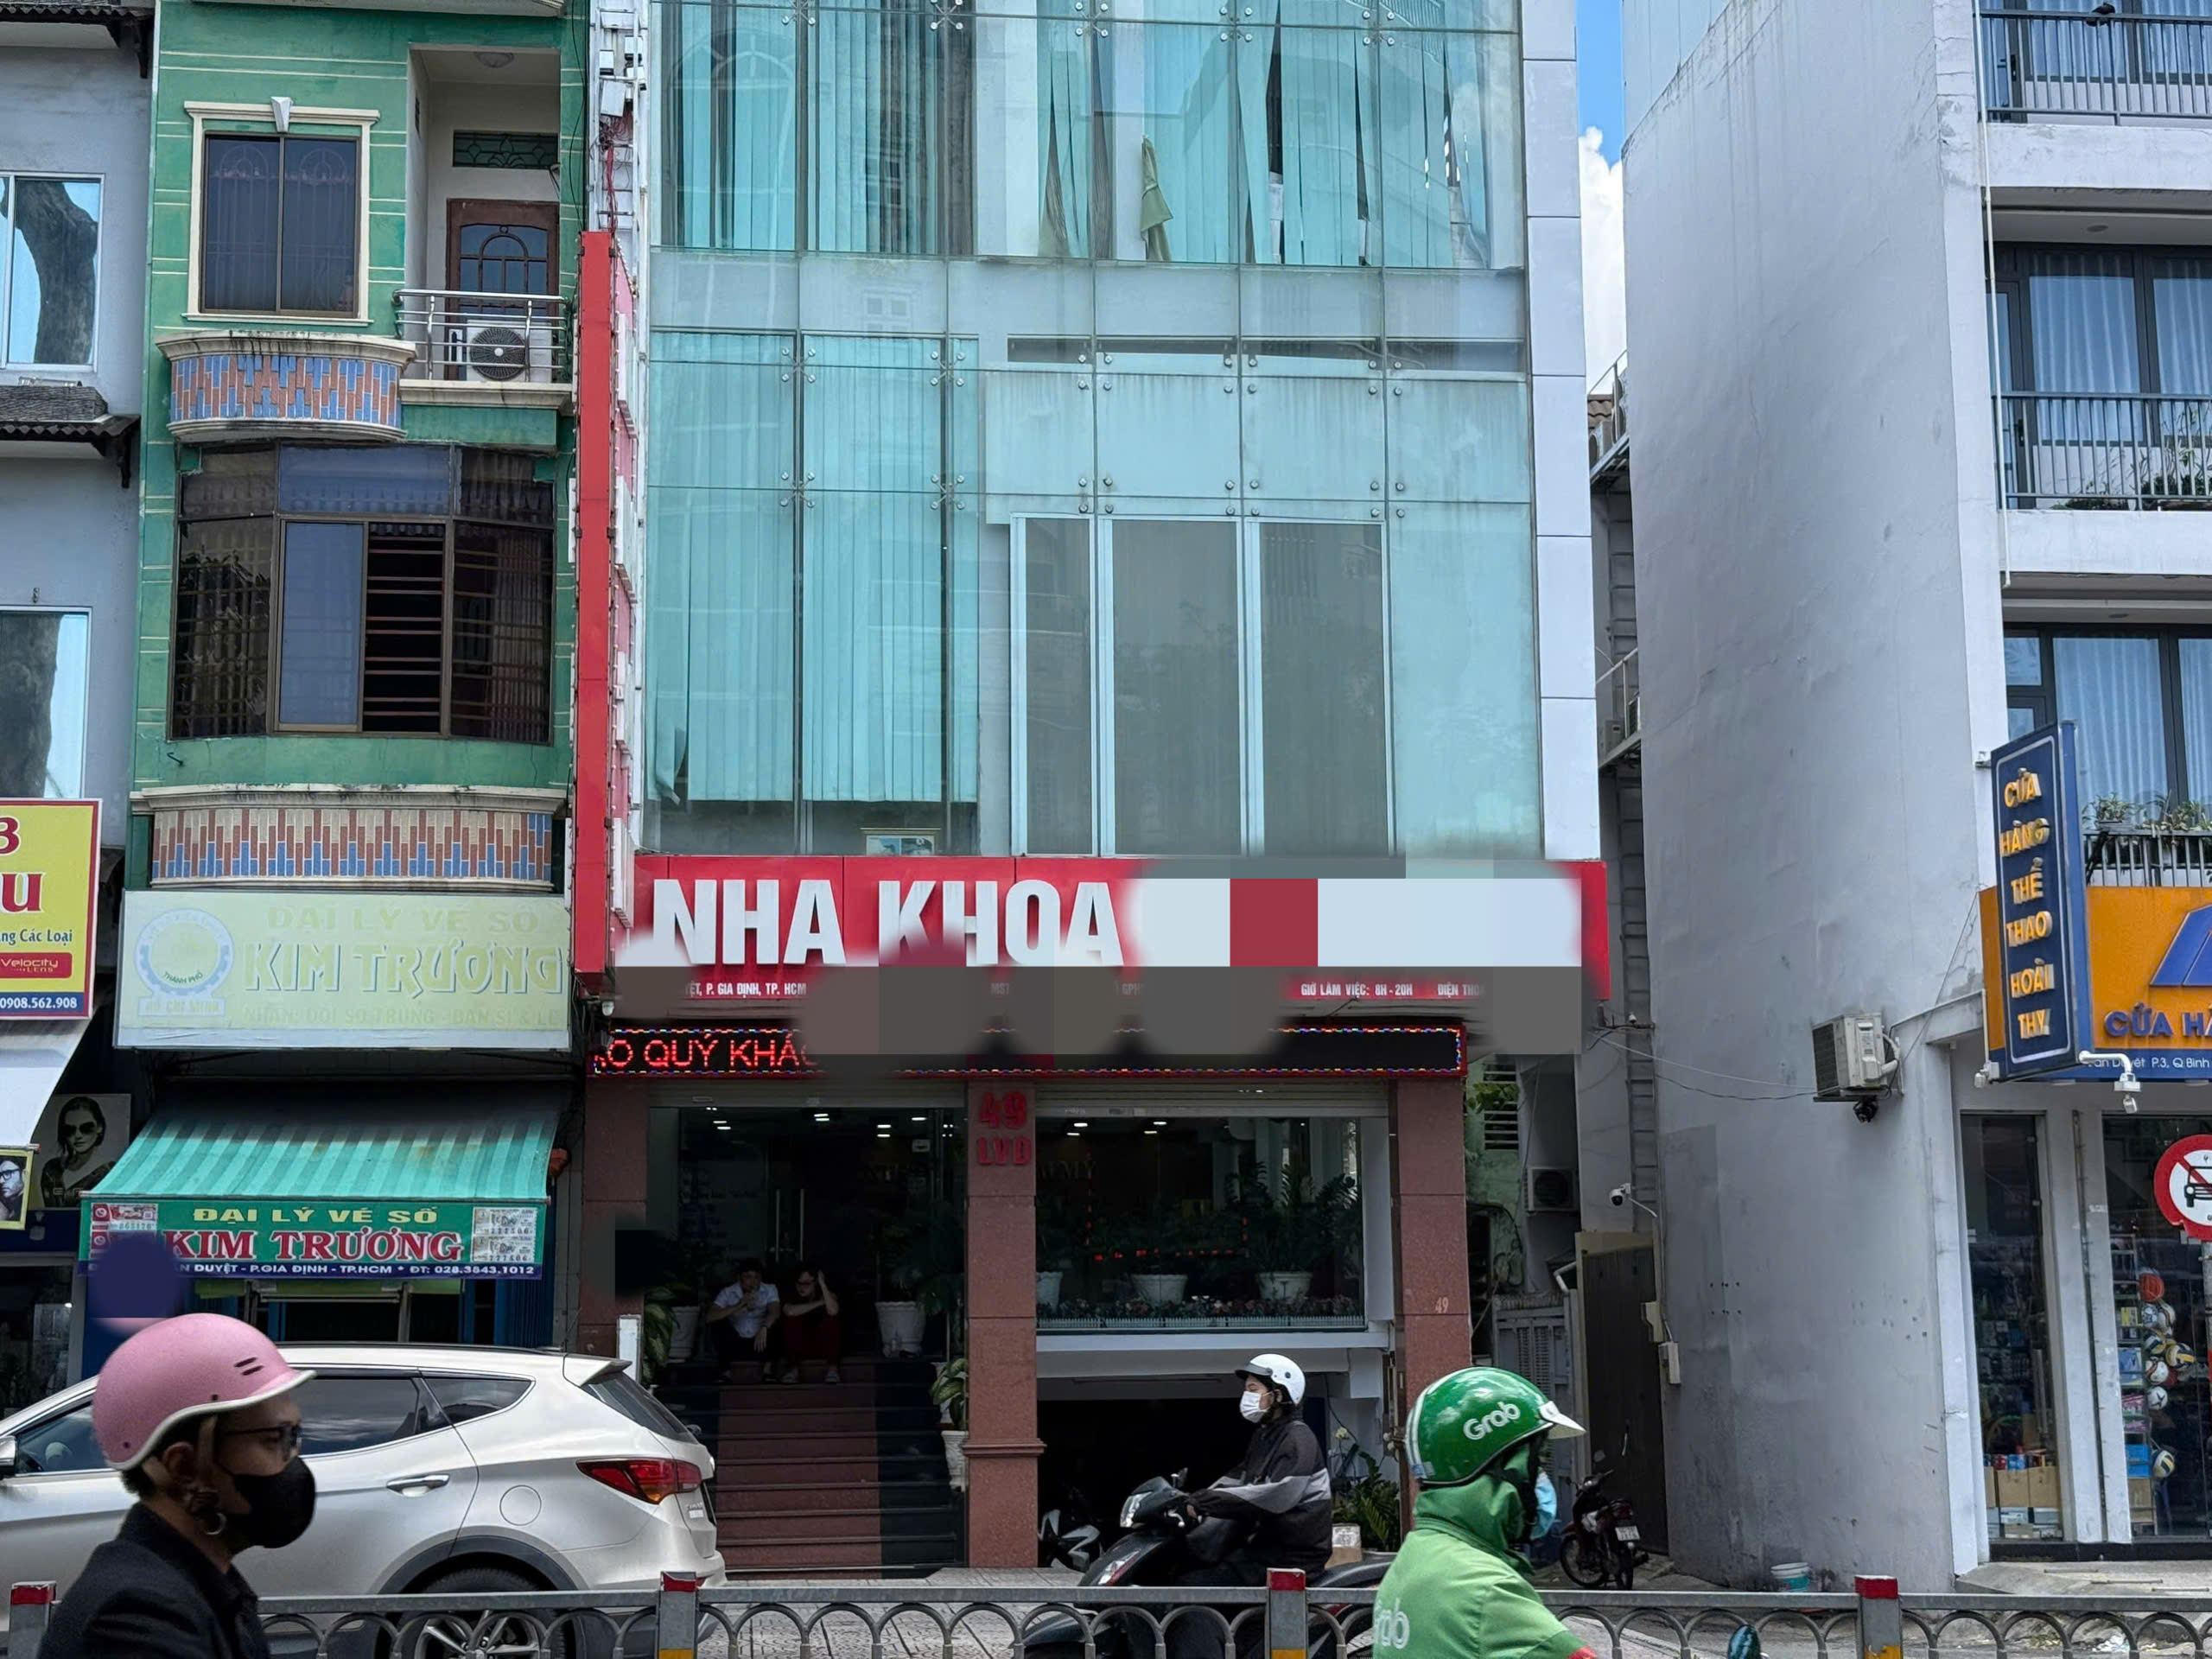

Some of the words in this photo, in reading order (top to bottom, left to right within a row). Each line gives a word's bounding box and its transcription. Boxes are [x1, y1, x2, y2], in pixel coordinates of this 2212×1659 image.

[2005, 767, 2042, 808] CỬA
[2000, 817, 2050, 858] HÀNG
[2011, 857, 2044, 906] THỂ
[0, 932, 16, 945] ng
[20, 928, 42, 942] Các
[47, 929, 73, 946] Loại
[653, 878, 847, 965] NHA
[878, 880, 1124, 966] KHOA
[2006, 911, 2053, 948] THAO
[1, 958, 59, 968] Velocity
[245, 944, 341, 992] KIM
[353, 940, 563, 1000] TRƯƠNG
[2011, 957, 2055, 998] HOÀI
[1, 997, 77, 1008] 0908.562.908
[706, 982, 715, 995] P.
[717, 982, 734, 995] GIA
[737, 982, 761, 998] ĐỊNH,
[766, 982, 780, 995] TP.
[784, 982, 807, 995] HCM
[1320, 982, 1341, 996] LÀM
[1375, 983, 1387, 996] 8H
[1395, 983, 1413, 996] 20H
[2018, 1009, 2050, 1039] THY
[2104, 1002, 2173, 1037] CỬA
[644, 1033, 719, 1067] QUÝ
[2172, 1058, 2183, 1068] Q
[979, 1091, 1027, 1129] 49
[194, 1208, 257, 1224] ĐẠI
[272, 1206, 315, 1222] LÝ
[328, 1207, 373, 1223] VÉ
[387, 1206, 438, 1224] SỐ
[162, 1230, 257, 1260] KIM
[270, 1226, 465, 1262] TRƯƠNG
[194, 1262, 238, 1274] DUYỆT
[292, 1265, 327, 1274] ĐỊNH
[340, 1265, 392, 1274] TP.HCM
[1435, 1297, 1449, 1313] 49
[1463, 1401, 1521, 1440] Grab
